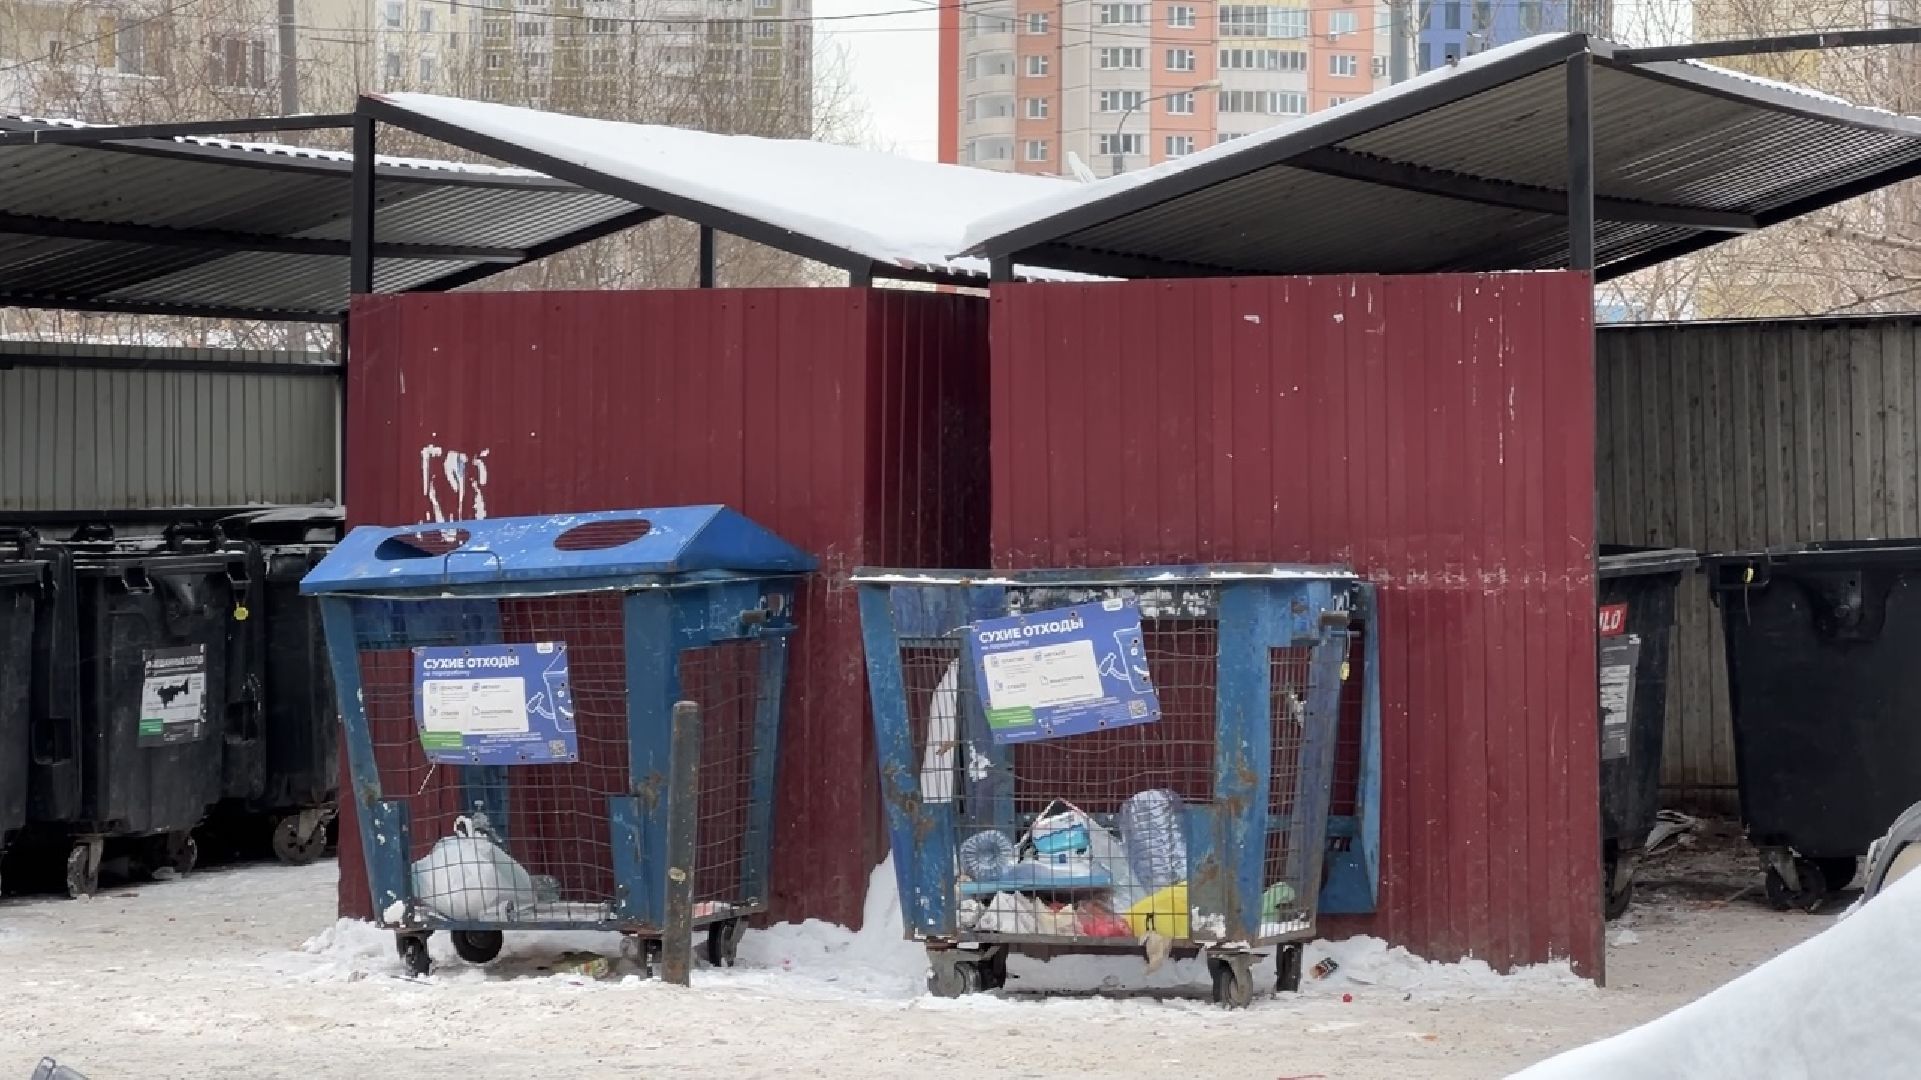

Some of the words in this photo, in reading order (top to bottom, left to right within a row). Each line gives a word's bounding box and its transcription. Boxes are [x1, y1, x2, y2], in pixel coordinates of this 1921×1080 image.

[979, 627, 1021, 643] СУХИЕ
[1023, 617, 1085, 637] ОТХОДЫ
[423, 658, 464, 669] СУХИЕ
[466, 655, 520, 669] ОТХОДЫ
